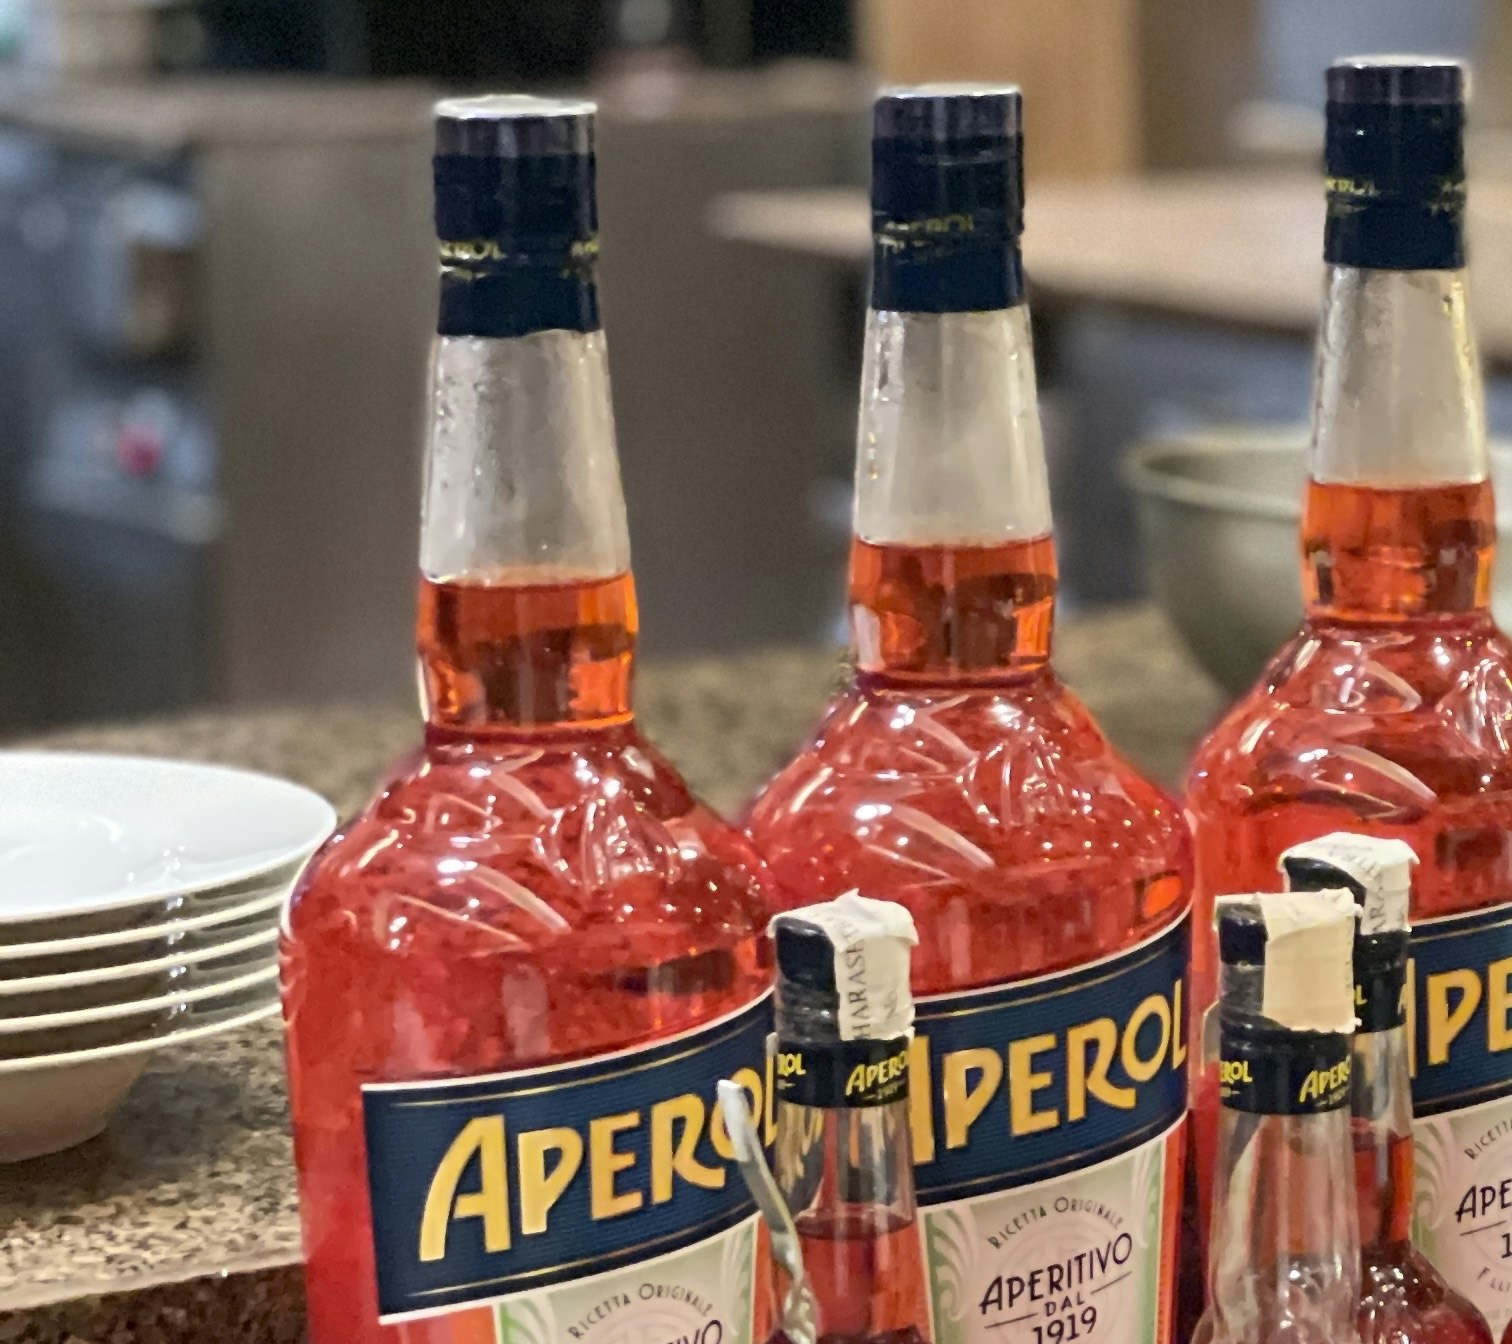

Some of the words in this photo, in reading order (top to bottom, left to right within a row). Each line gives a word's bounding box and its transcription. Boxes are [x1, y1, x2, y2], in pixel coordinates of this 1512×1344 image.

[845, 1050, 908, 1096] APERO
[909, 978, 1187, 1166] PEROL
[987, 1205, 1048, 1250] RICETTA
[978, 1232, 1133, 1316] APERITIVO
[567, 1293, 632, 1340] RICETTA
[1044, 1292, 1086, 1317] DAL
